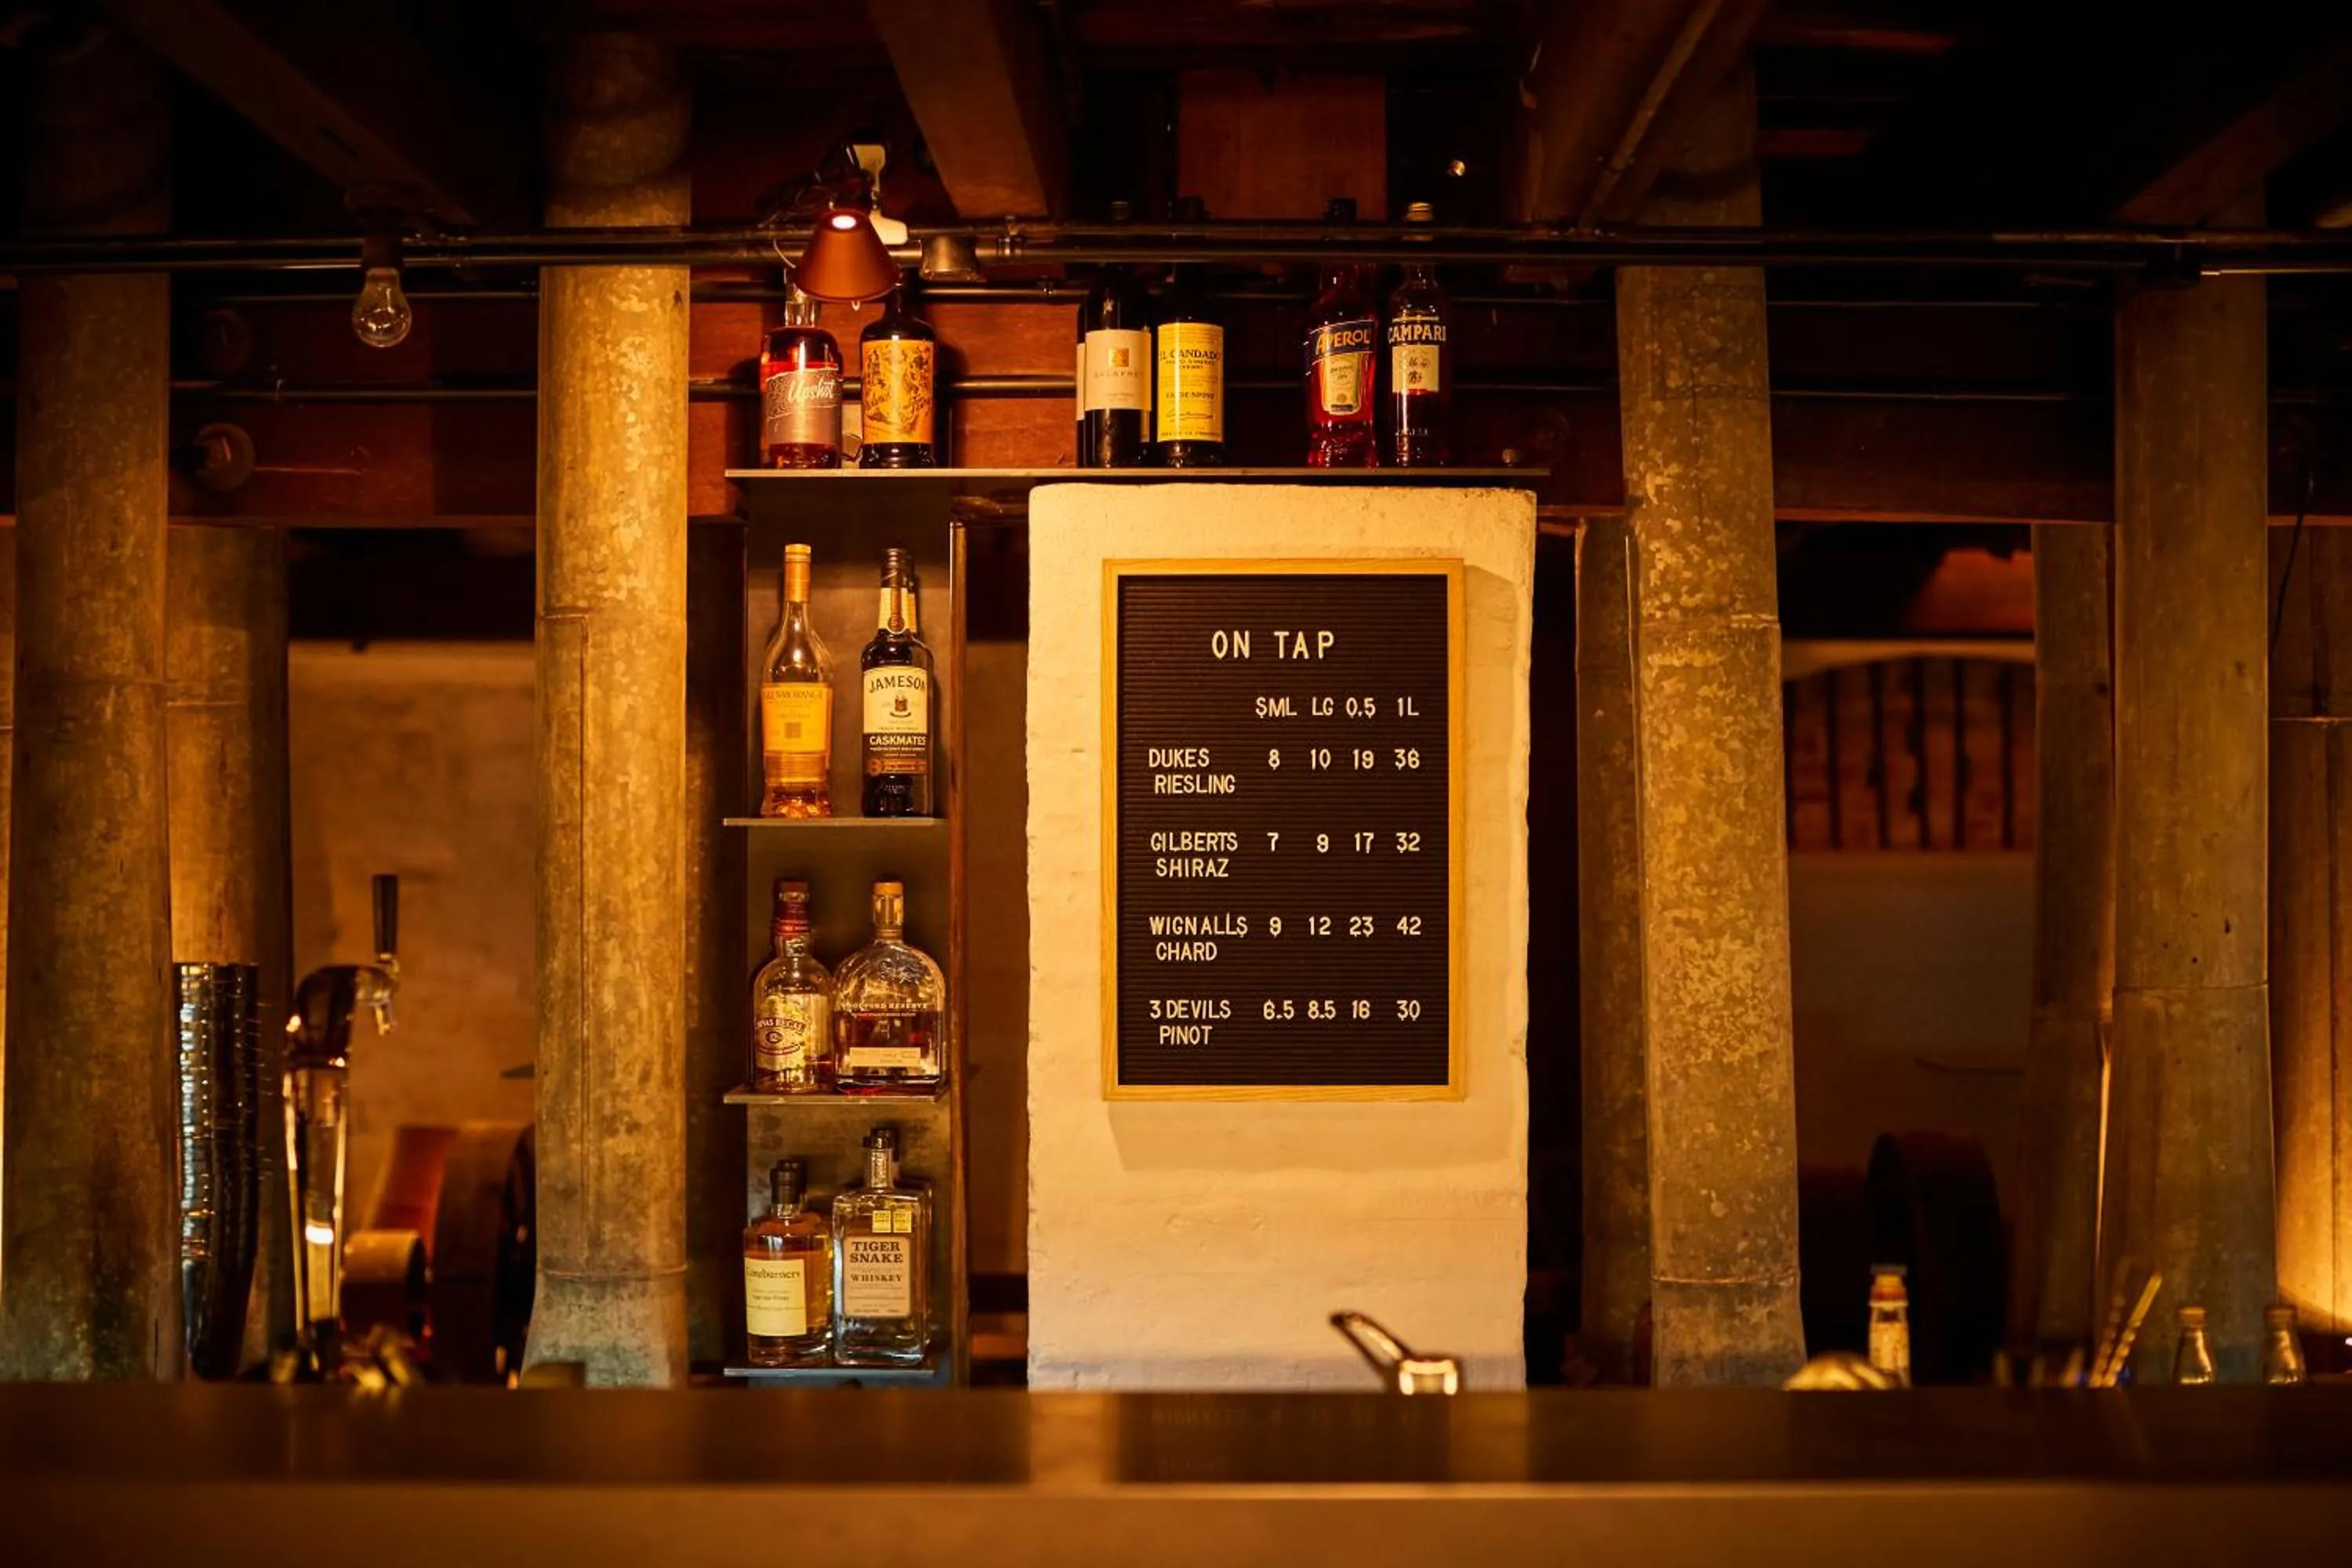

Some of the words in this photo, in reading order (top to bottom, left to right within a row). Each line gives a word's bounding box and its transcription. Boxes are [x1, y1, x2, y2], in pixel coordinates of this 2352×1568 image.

[1387, 324, 1446, 343] CAMPARI
[1211, 630, 1250, 659] ON
[1273, 630, 1334, 659] TAP
[1312, 696, 1334, 717] LG
[1345, 697, 1376, 719] 0.5
[1397, 696, 1420, 717] 1L
[869, 735, 926, 746] CASKMATES
[1149, 747, 1210, 768] DUKES
[1268, 748, 1280, 771] 8
[1310, 748, 1331, 770] 10
[1352, 749, 1374, 770] 19
[1394, 747, 1420, 771] 36
[1154, 774, 1236, 795] RIESLING
[1150, 831, 1238, 853] GILBERTS
[1266, 832, 1279, 852] 7
[1316, 833, 1329, 854] 9
[1354, 832, 1374, 854] 17
[1396, 832, 1421, 854] 32
[1156, 857, 1229, 878] SHIRAZ
[1149, 913, 1248, 938] WIGNALLS
[1269, 916, 1282, 938] 9
[1308, 916, 1331, 935] 12
[1349, 916, 1374, 938] 23
[1396, 916, 1421, 935] 42
[1156, 941, 1218, 962] CHARD
[1149, 1000, 1162, 1019] 3
[1166, 1000, 1232, 1020] DEVILS
[1263, 999, 1294, 1020] 6.5
[1307, 1000, 1337, 1020] 8.5
[1352, 1000, 1370, 1019] 16
[1396, 1000, 1421, 1022] 30
[1160, 1025, 1213, 1045] PINOT
[851, 1241, 900, 1252] TIGER
[849, 1253, 903, 1263] SNAKE
